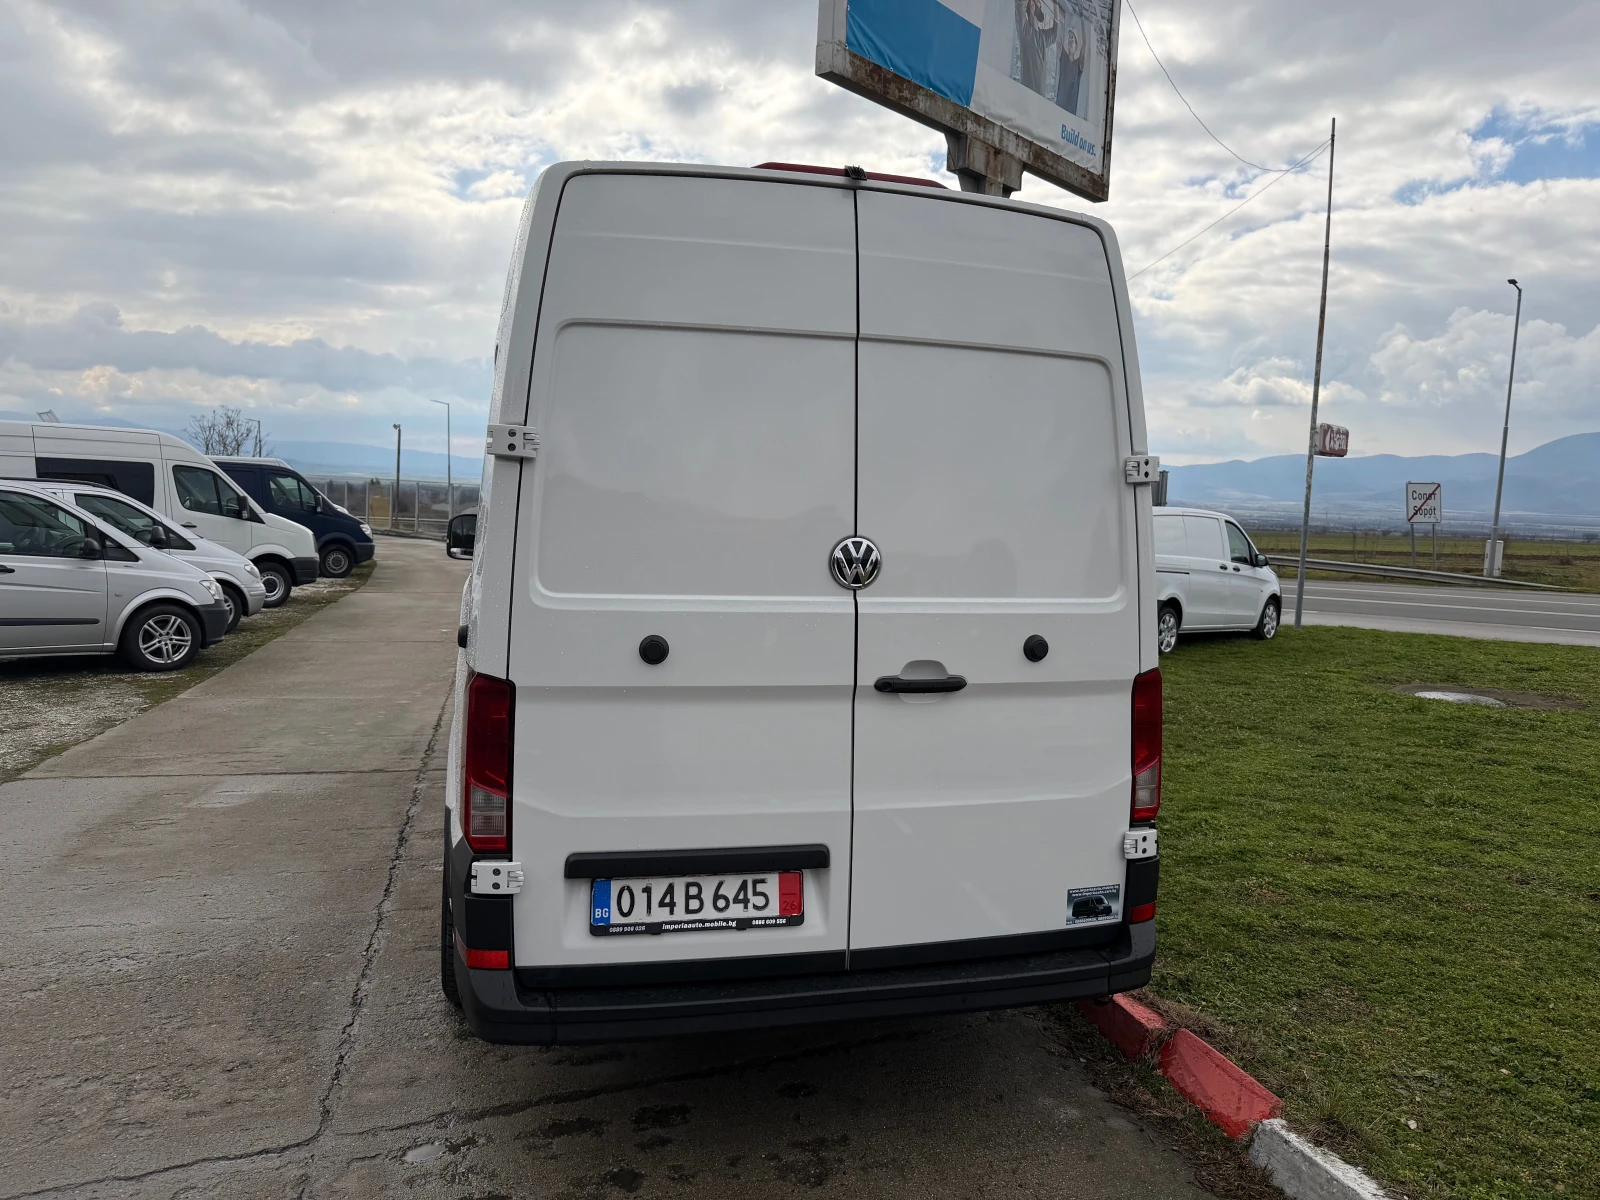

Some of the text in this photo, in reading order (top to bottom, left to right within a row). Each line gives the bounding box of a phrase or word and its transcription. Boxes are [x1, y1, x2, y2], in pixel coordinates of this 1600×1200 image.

[1061, 124, 1096, 156] Build on us.
[1413, 506, 1436, 518] Sopot
[782, 900, 798, 911] 26
[595, 907, 610, 919] BG
[661, 920, 738, 931] imperiaauto.mobile.bg
